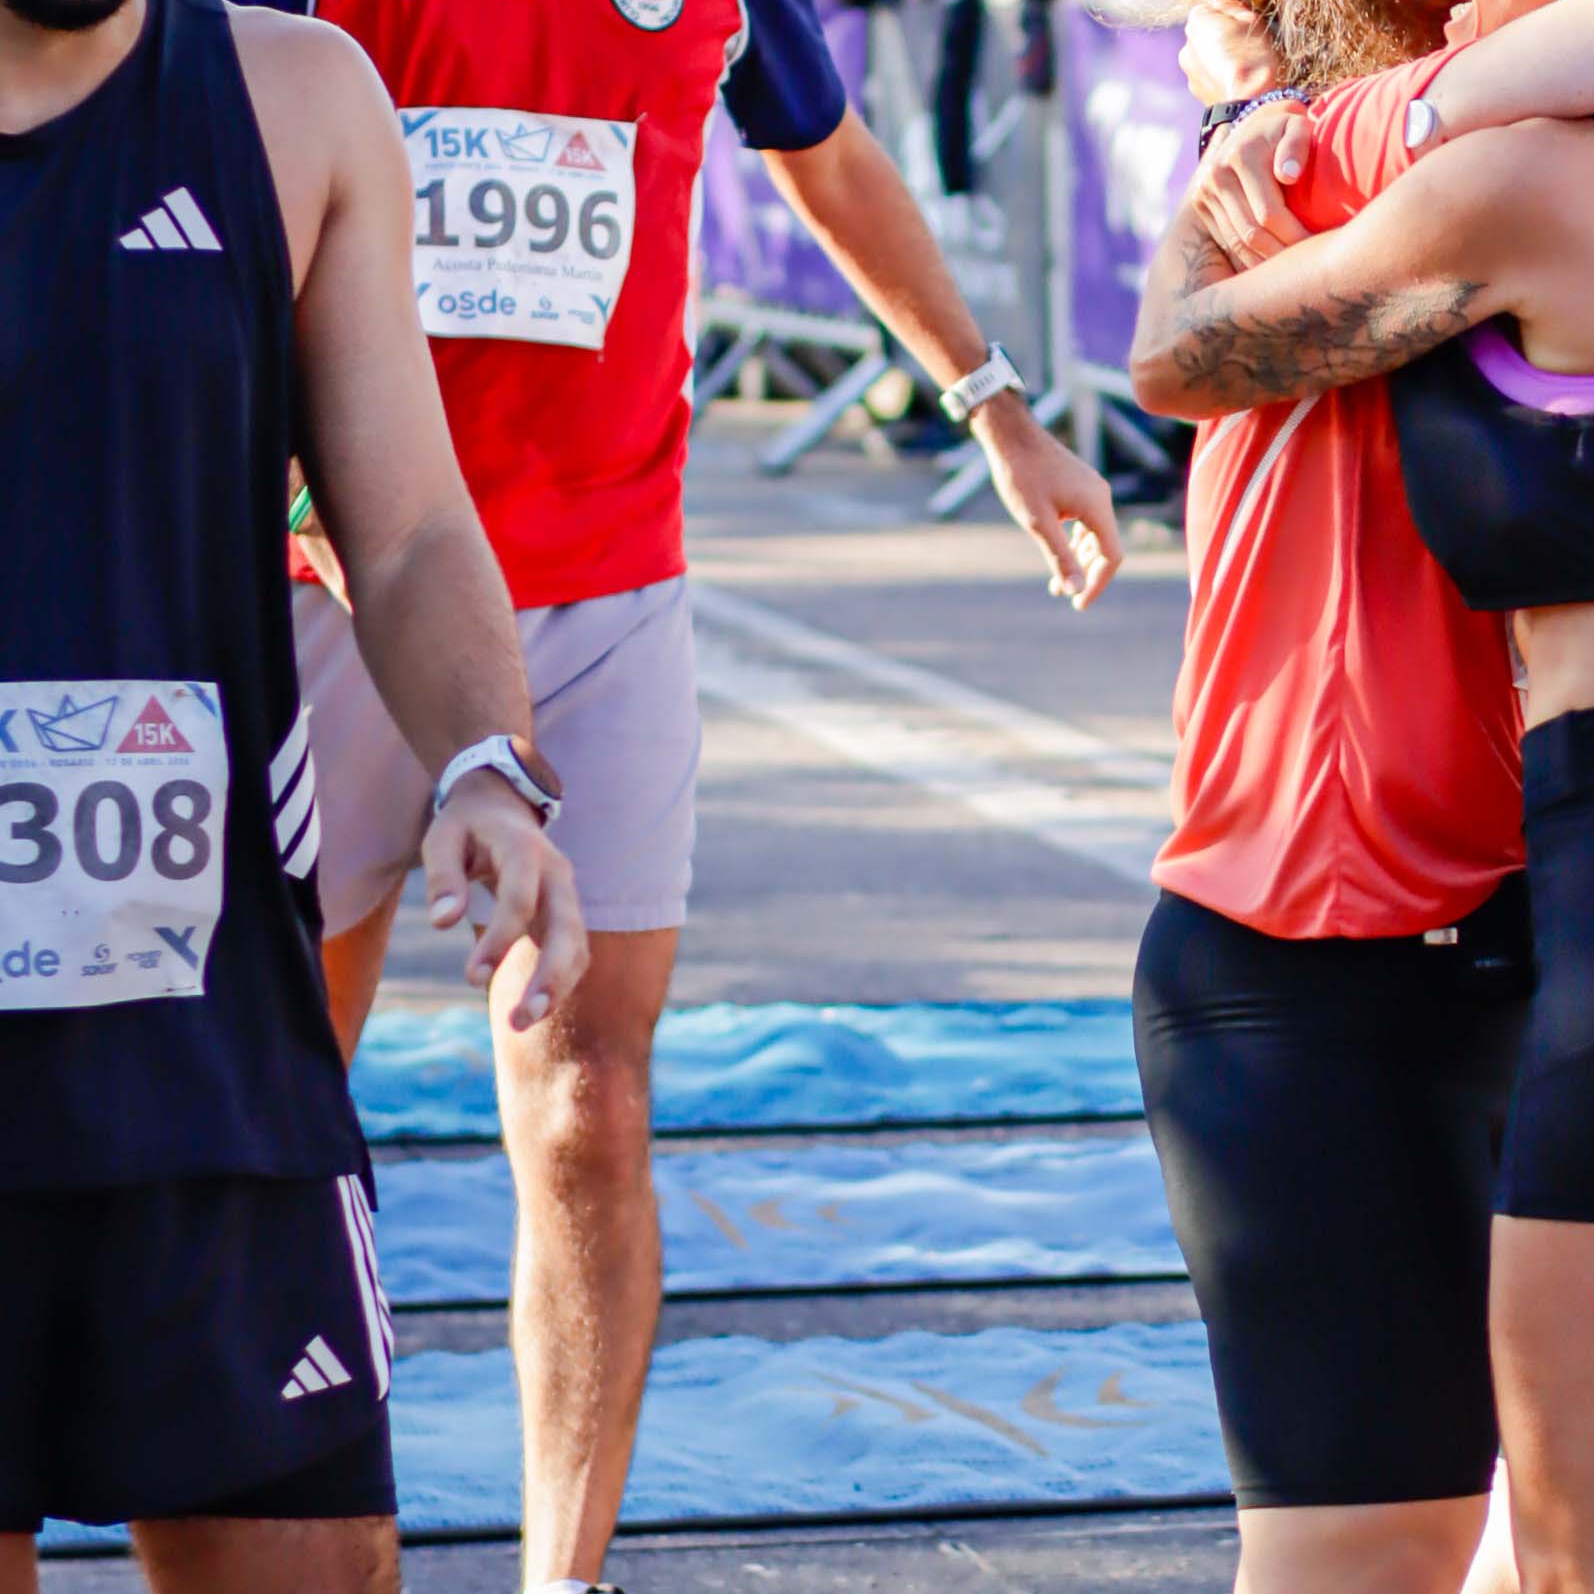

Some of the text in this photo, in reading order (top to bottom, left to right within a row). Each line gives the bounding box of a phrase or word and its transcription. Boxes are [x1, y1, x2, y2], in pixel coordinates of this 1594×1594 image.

[424, 127, 489, 159] 15K
[415, 178, 621, 260] 1996
[437, 289, 517, 319] osde
[133, 723, 176, 746] 15K
